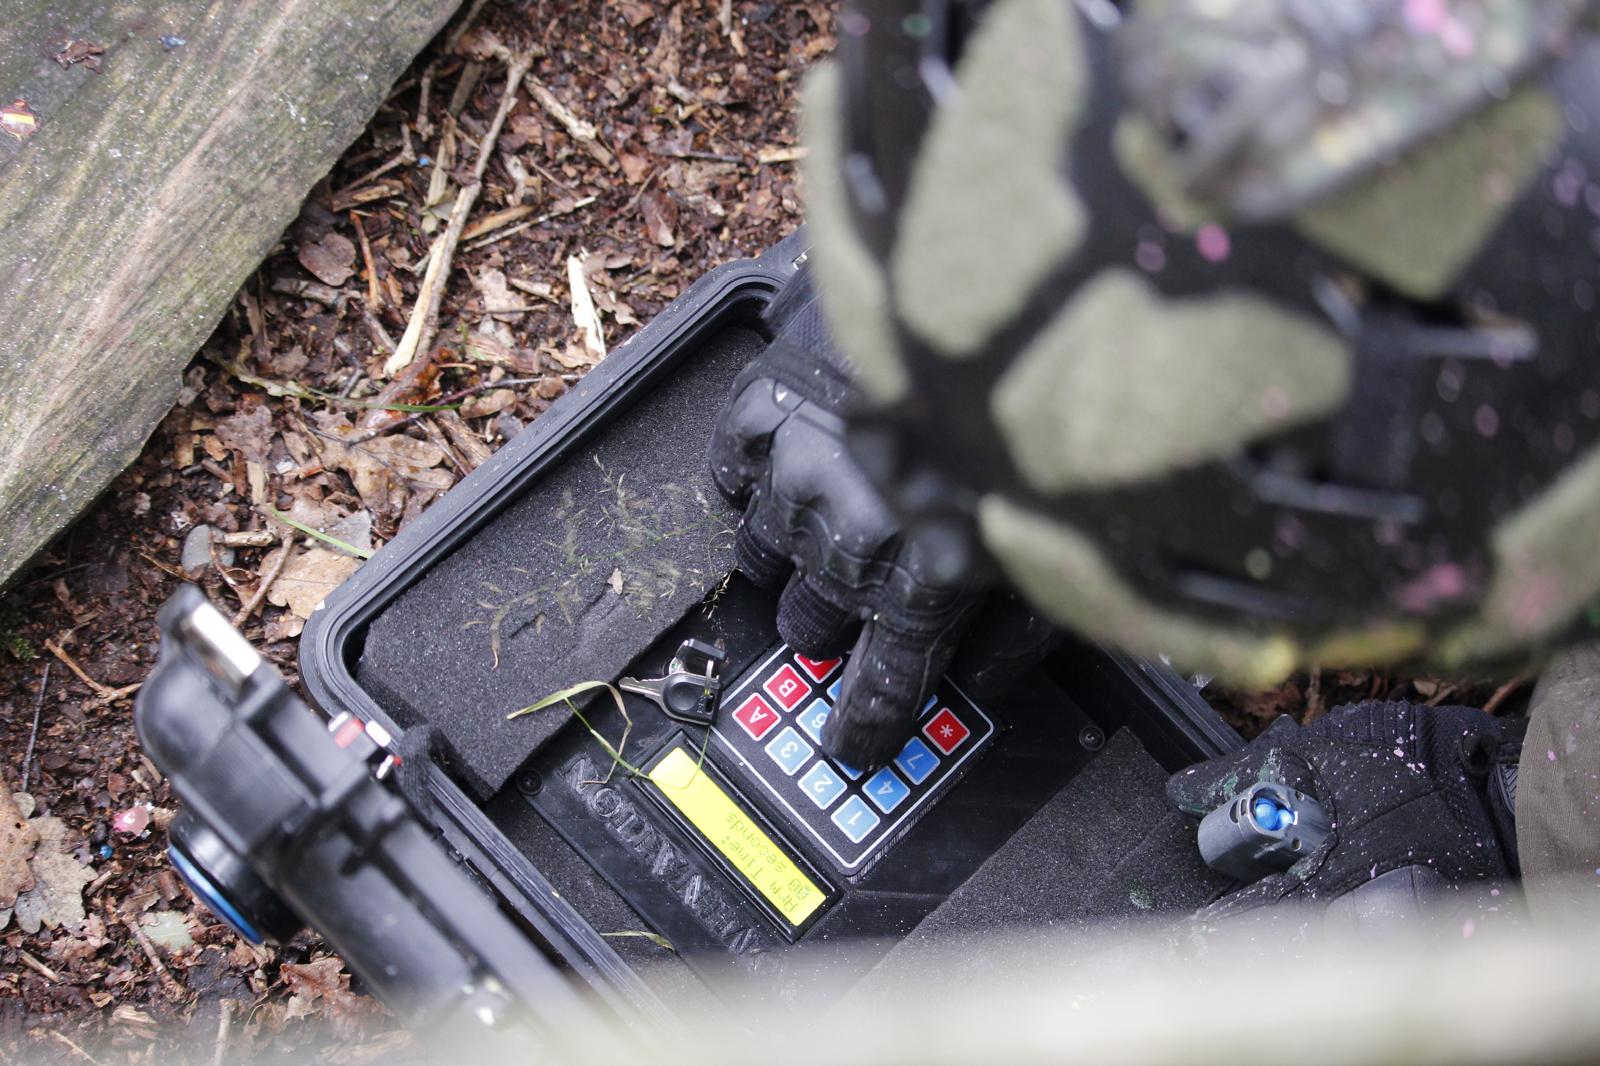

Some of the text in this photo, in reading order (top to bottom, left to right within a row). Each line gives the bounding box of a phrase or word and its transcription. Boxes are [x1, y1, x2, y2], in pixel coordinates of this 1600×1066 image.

[749, 705, 863, 825] 1 2 3 A
[778, 678, 894, 795] 4 6 B
[906, 753, 924, 770] 7
[556, 753, 785, 990] MINATION
[721, 836, 798, 912] Arm Time:
[725, 811, 787, 873] seconds
